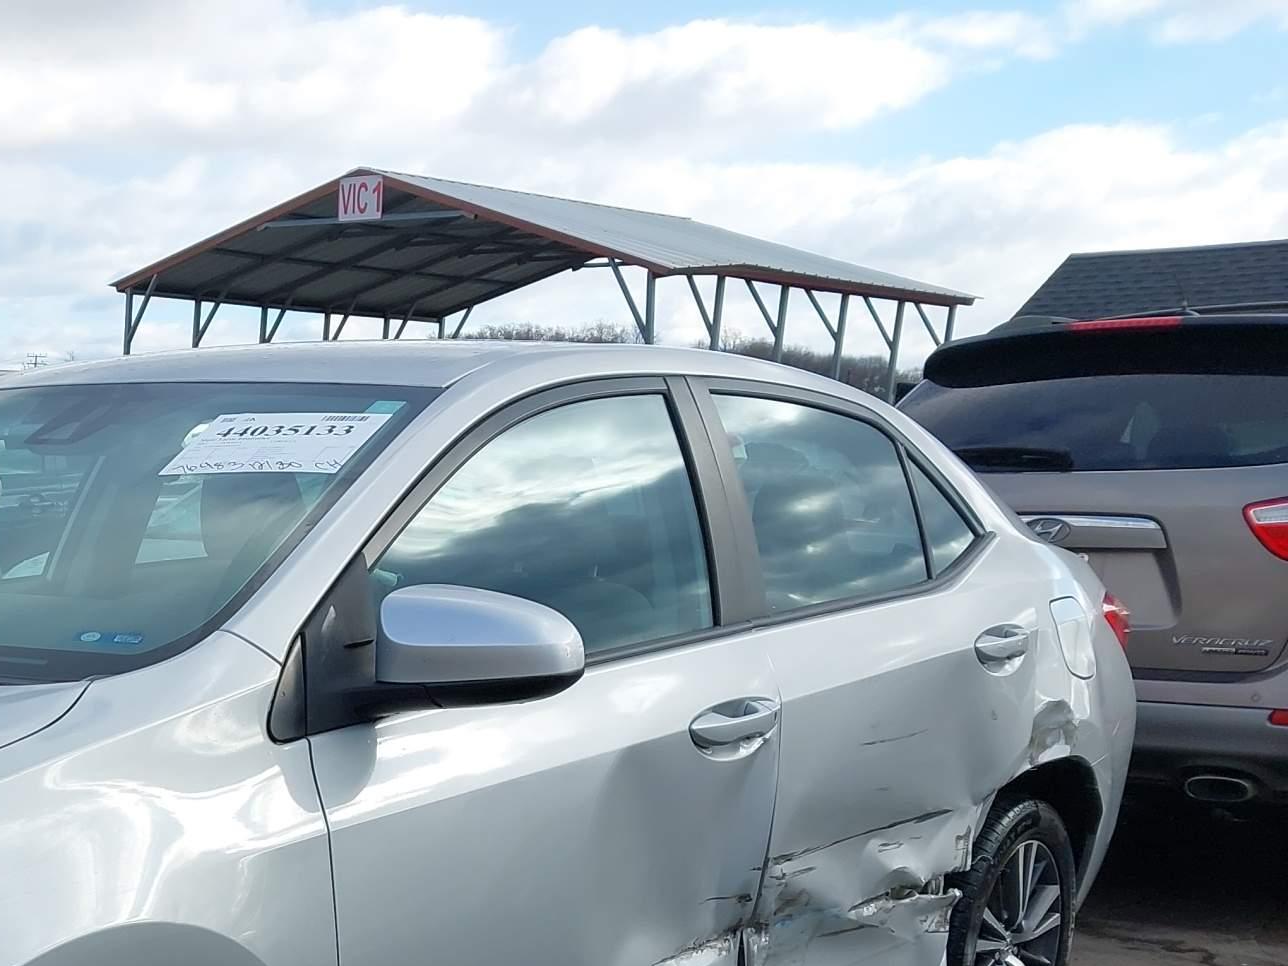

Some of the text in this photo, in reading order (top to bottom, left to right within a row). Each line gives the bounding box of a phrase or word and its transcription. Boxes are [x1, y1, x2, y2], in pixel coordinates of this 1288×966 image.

[341, 181, 381, 215] VIC 1
[216, 424, 355, 438] 44035133
[1172, 634, 1273, 647] VERACRUZ
